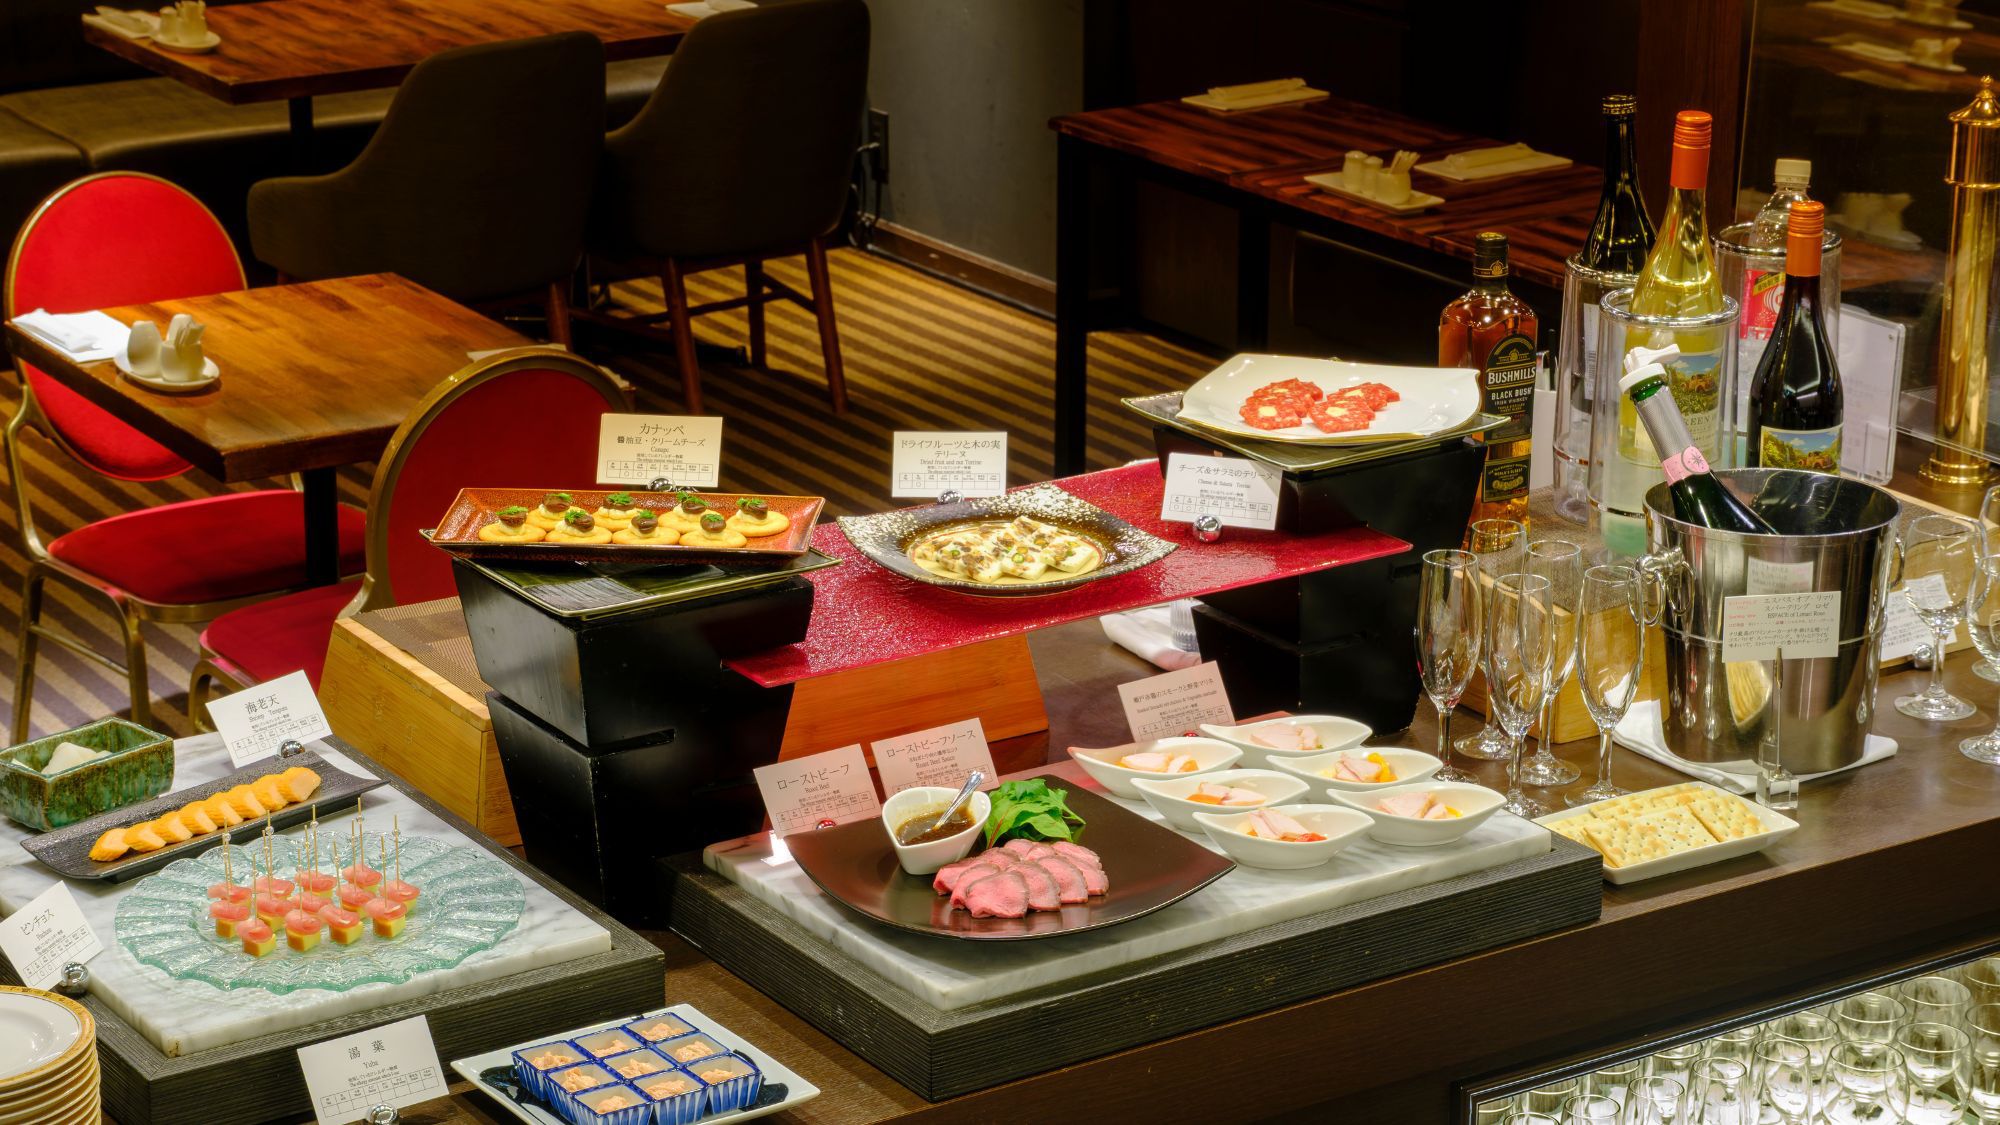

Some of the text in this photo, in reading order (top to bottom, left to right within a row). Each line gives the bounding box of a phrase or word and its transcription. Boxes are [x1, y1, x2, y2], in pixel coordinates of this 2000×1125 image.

[1488, 367, 1536, 385] BUSHMILLS
[1491, 387, 1532, 400] BLACK BUSH
[640, 423, 685, 435] カナッペ
[901, 439, 1000, 449] ドライフルーツと木の実
[935, 450, 966, 458] テリーヌ
[245, 694, 280, 714] 海老天
[886, 730, 976, 757] ローストビーフソース
[777, 764, 849, 789] ローストビーフ
